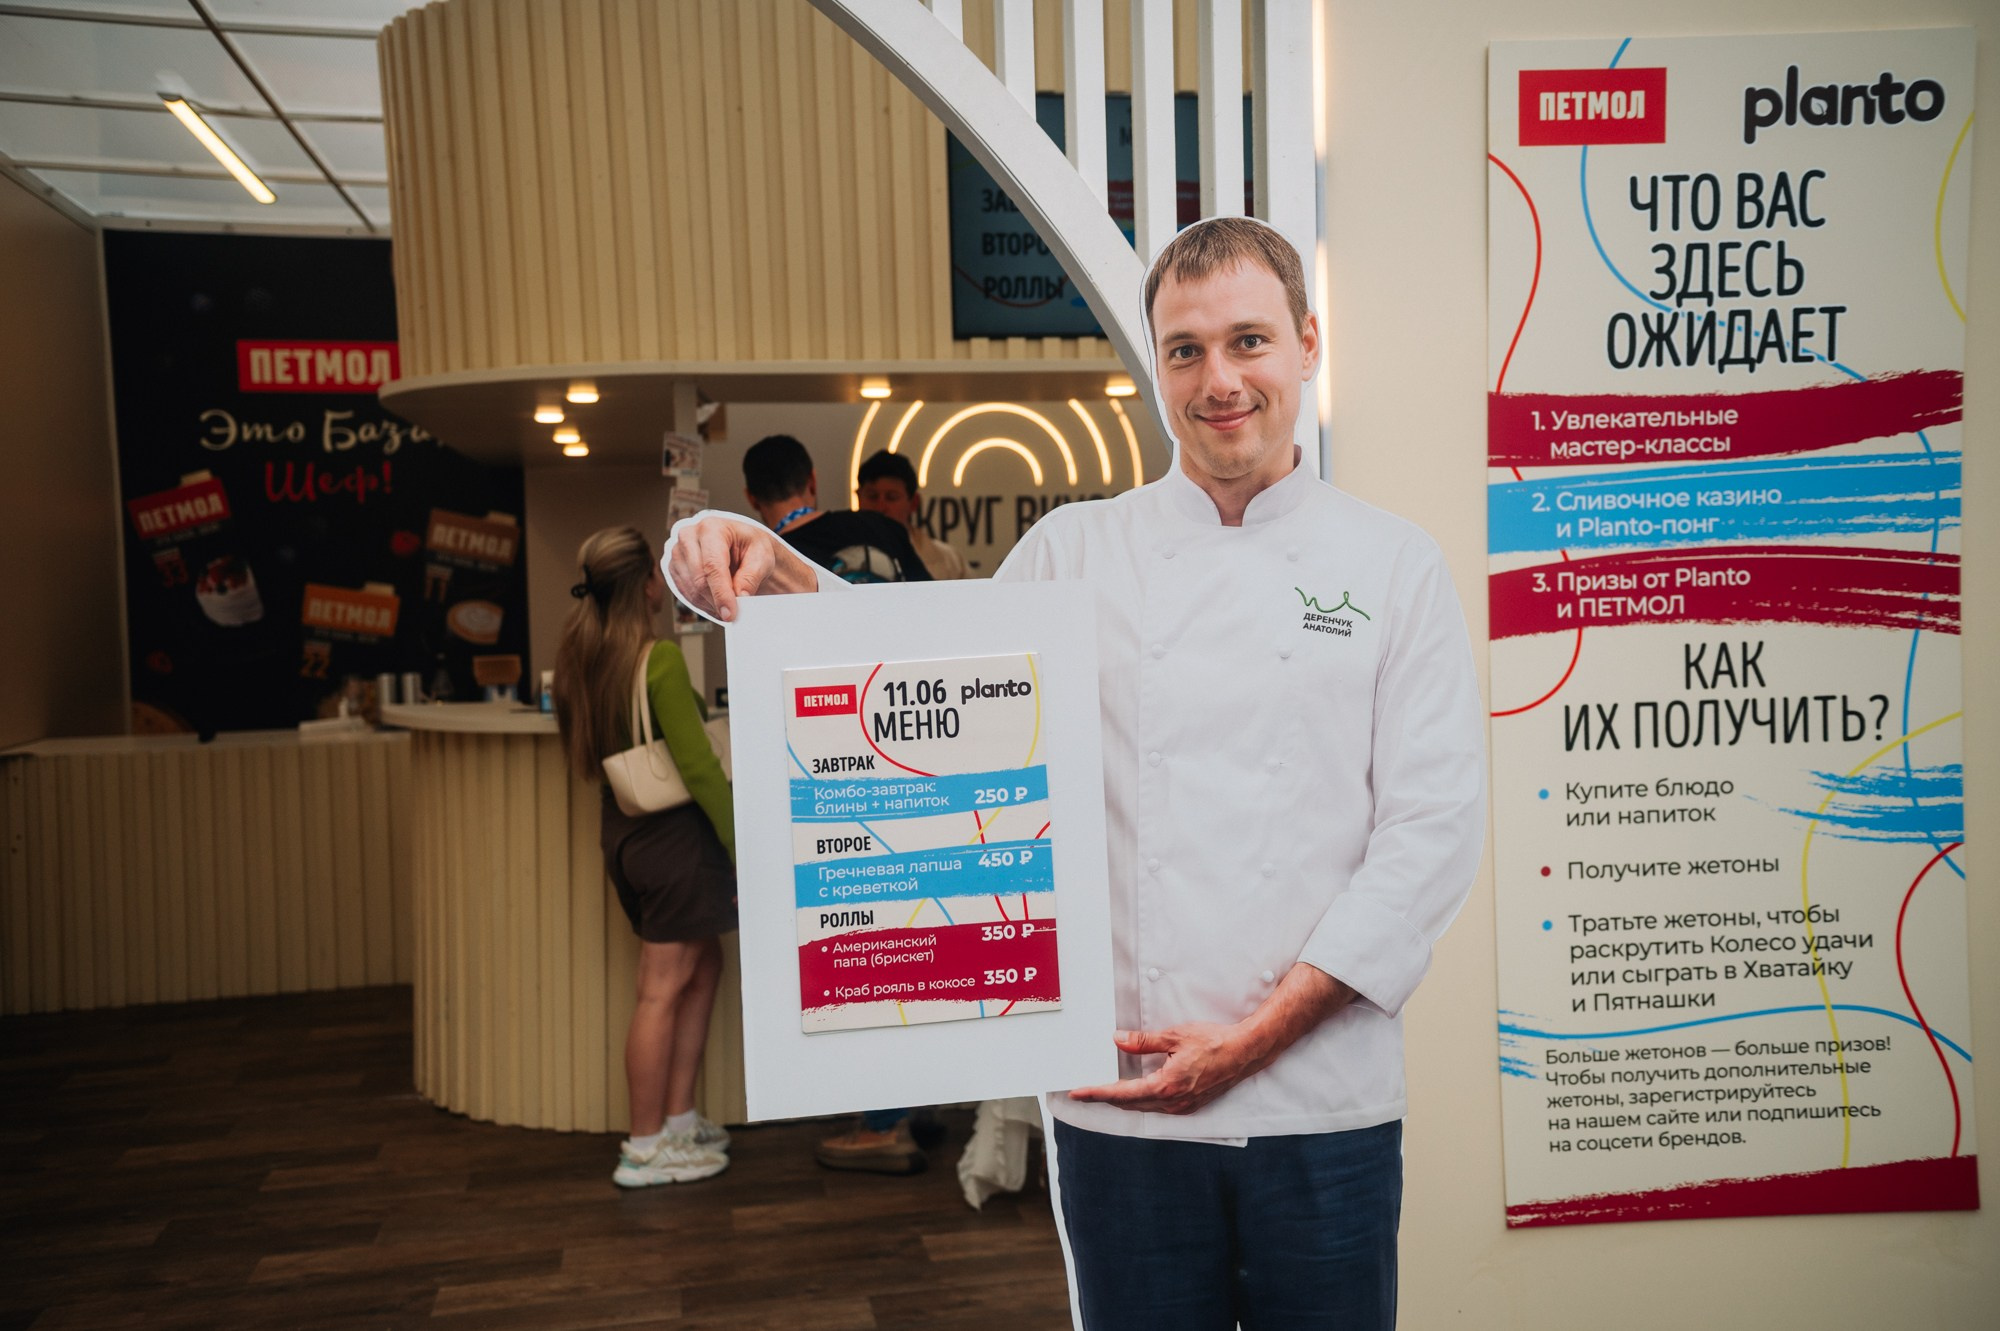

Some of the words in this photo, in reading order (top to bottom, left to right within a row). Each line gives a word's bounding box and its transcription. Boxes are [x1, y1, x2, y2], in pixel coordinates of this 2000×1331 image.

[1539, 90, 1646, 121] ПЕТМОЛ
[1743, 65, 1945, 144] planto
[1630, 173, 1721, 232] ЧТО
[1737, 169, 1826, 230] ВАС
[982, 233, 1049, 256] ВТОРО
[1649, 240, 1805, 307] ЗДЕСЬ
[983, 276, 1063, 299] РОЛЛЫ
[1606, 305, 1847, 374] ОЖИДАЕТ
[249, 348, 392, 385] ПЕТМОЛ
[198, 408, 306, 451] Это
[1531, 412, 1546, 432] 1.
[1550, 408, 1739, 430] Увлекательные
[1550, 436, 1730, 459] мастер-классы
[264, 461, 393, 504] Шеф!
[137, 490, 224, 532] ПЕТМОЛ
[1531, 492, 1551, 513] 2.
[1556, 489, 1691, 512] Сливочное
[1696, 487, 1782, 508] казино
[911, 496, 1004, 546] КРУГ
[1556, 523, 1572, 538] и
[1578, 515, 1720, 538] Planto-понг
[1532, 573, 1551, 593] 3.
[1557, 571, 1638, 596] Призы
[1643, 572, 1670, 589] от
[1675, 566, 1751, 589] Planto
[1303, 612, 1353, 628] ДЕРЕНЧУК
[1557, 603, 1572, 618] и
[1579, 595, 1685, 618] ПЕТМОЛ
[1303, 622, 1352, 637] АНАТОЛИЙ
[1684, 641, 1766, 690] КАК
[803, 693, 849, 708] ПЕТМОЛ
[883, 679, 947, 706] 11.06
[961, 677, 1032, 705] planto
[873, 707, 960, 742] МЕНЮ
[1564, 703, 1621, 752] ИХ
[1634, 694, 1889, 748] ПОЛУЧИТЬ?
[812, 755, 875, 774] ЗАВТРАК
[814, 781, 936, 800] Комбо-завтрак:
[974, 788, 1009, 805] 250
[1565, 780, 1648, 804] Купите
[1655, 777, 1735, 801] блюдо
[815, 801, 867, 815] блины
[872, 801, 881, 810] +
[885, 795, 950, 811] напиток
[1566, 809, 1612, 827] или
[1618, 804, 1716, 826] напиток
[816, 836, 871, 855] ВТОРОЕ
[818, 862, 905, 883] Гречневая
[908, 859, 962, 875] лапша
[978, 852, 1014, 868] 450
[1568, 858, 1682, 882] Получите
[1687, 856, 1780, 876] жетоны
[819, 887, 829, 898] с
[832, 878, 918, 899] креветкой
[820, 910, 874, 928] РОЛЛЫ
[1568, 913, 1658, 936] Тратьте
[1664, 908, 1761, 930] жетоны,
[1766, 905, 1839, 925] чтобы
[833, 934, 937, 956] Американский
[981, 925, 1016, 941] 350
[833, 956, 867, 969] папа
[870, 949, 935, 969] (брискет)
[1570, 938, 1704, 963] раскрутить
[1710, 934, 1796, 954] Колесо
[1801, 931, 1873, 956] удачи
[835, 983, 870, 999] Краб
[873, 981, 915, 999] рояль
[918, 980, 926, 991] в
[929, 976, 976, 990] кокосе
[984, 969, 1018, 985] 350
[1571, 969, 1616, 986] или
[1621, 964, 1718, 988] сыграть
[1724, 964, 1737, 979] в
[1743, 958, 1853, 982] Хватайку
[1571, 996, 1587, 1012] и
[1593, 991, 1716, 1012] Пятнашки
[1545, 1046, 1620, 1065] Больше
[1624, 1042, 1707, 1062] жетонов
[1735, 1037, 1809, 1056] больше
[1814, 1035, 1891, 1059] призов!
[1546, 1068, 1606, 1086] Чтобы
[1610, 1064, 1700, 1087] получить
[1704, 1058, 1871, 1082] дополнительные
[1547, 1090, 1625, 1110] жетоны,
[1628, 1083, 1816, 1108] зарегистрируйтесь
[1548, 1117, 1571, 1131] на
[1575, 1113, 1641, 1129] нашем
[1646, 1107, 1700, 1126] сайте
[1705, 1108, 1742, 1124] или
[1747, 1102, 1882, 1124] подпишитесь
[1549, 1138, 1572, 1152] на
[1576, 1132, 1653, 1154] соцсети
[1658, 1129, 1746, 1153] брендов.
